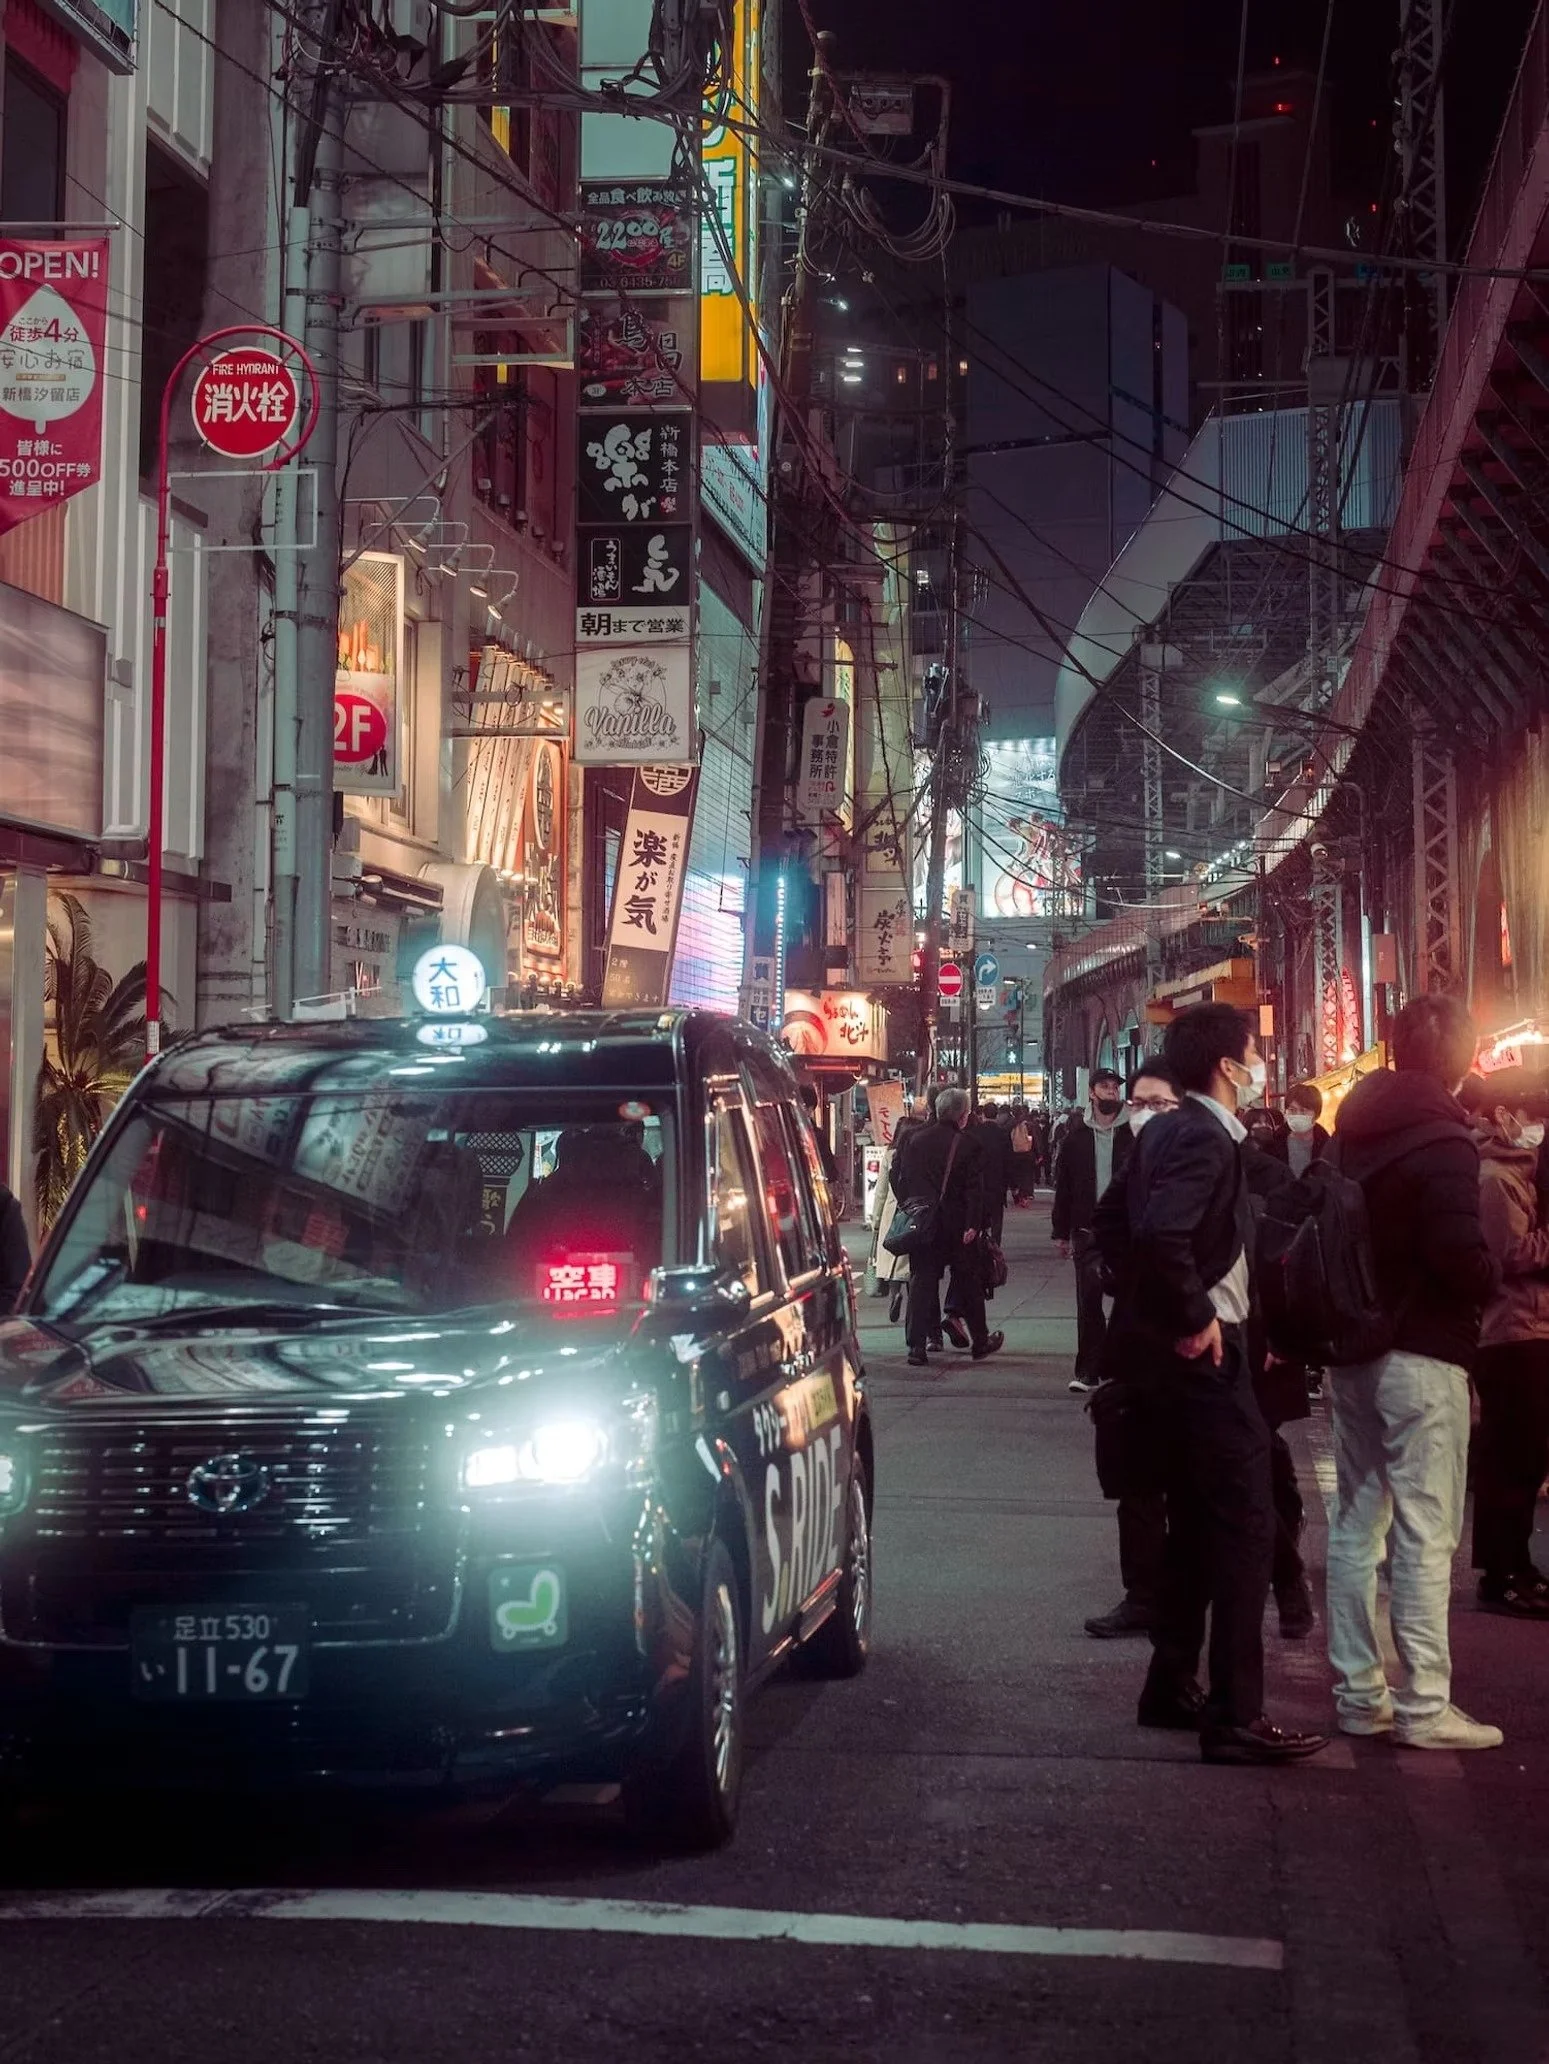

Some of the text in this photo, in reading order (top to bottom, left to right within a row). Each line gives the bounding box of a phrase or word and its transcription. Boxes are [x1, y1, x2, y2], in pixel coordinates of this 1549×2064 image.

[0, 251, 99, 279] OPEN!
[9, 318, 79, 342] 徒歩4分
[212, 363, 234, 375] FIRE
[3, 387, 80, 402] 新橋汐留店
[203, 381, 289, 423] 消火栓
[17, 440, 63, 456] 皆様に
[660, 424, 680, 493] 新橋本店
[9, 480, 65, 496] 進呈中!
[580, 613, 685, 636] 朝まで営業
[584, 703, 677, 740] Vanilla
[809, 734, 824, 779] 事務所
[621, 829, 667, 935] 楽が気
[428, 956, 460, 1010] 大和
[549, 1263, 617, 1289] 空車
[141, 1645, 299, 1694] い 11-67
